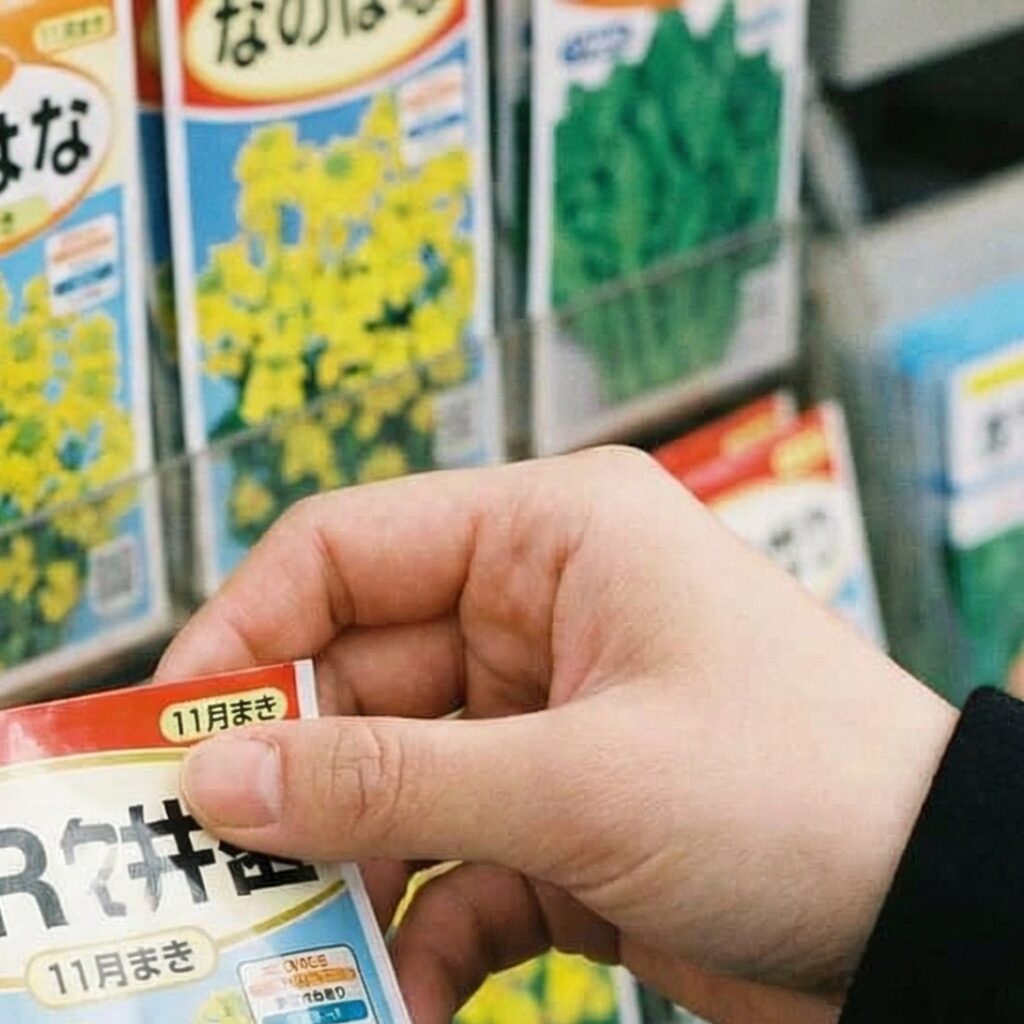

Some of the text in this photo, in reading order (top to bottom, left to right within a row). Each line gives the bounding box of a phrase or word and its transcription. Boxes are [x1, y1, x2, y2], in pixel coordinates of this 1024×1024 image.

[172, 694, 277, 735] 11月まき
[49, 940, 197, 995] 11月まき
